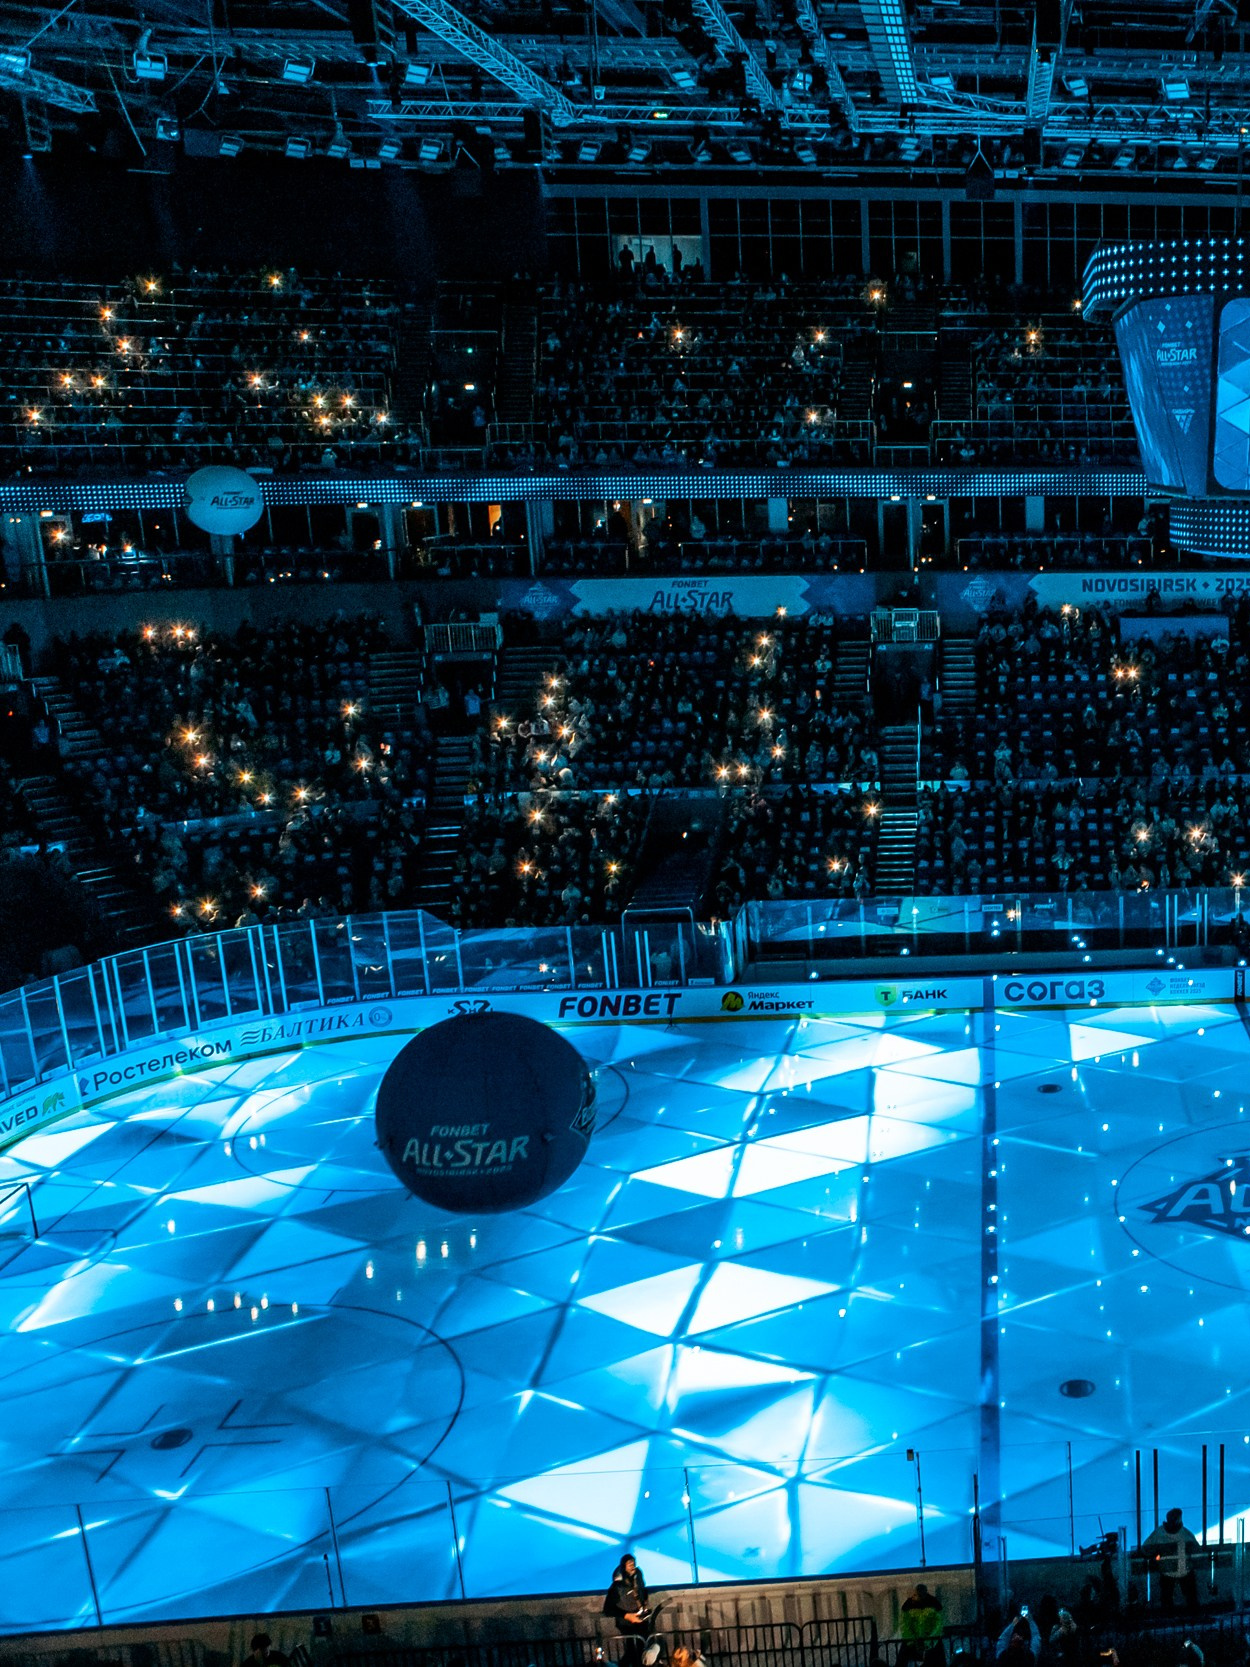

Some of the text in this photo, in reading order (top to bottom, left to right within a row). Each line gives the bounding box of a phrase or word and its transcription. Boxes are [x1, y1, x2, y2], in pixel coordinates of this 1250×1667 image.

[672, 580, 708, 588] FONBET
[1082, 578, 1197, 592] NOVOSIBIRSK
[902, 990, 947, 1000] БАНК
[558, 993, 682, 1018] FONBET
[748, 1000, 814, 1011] Маркет
[260, 1013, 364, 1043] БАЛТИКА
[94, 1040, 233, 1091] Ростелеком
[430, 1123, 490, 1137] FONBET
